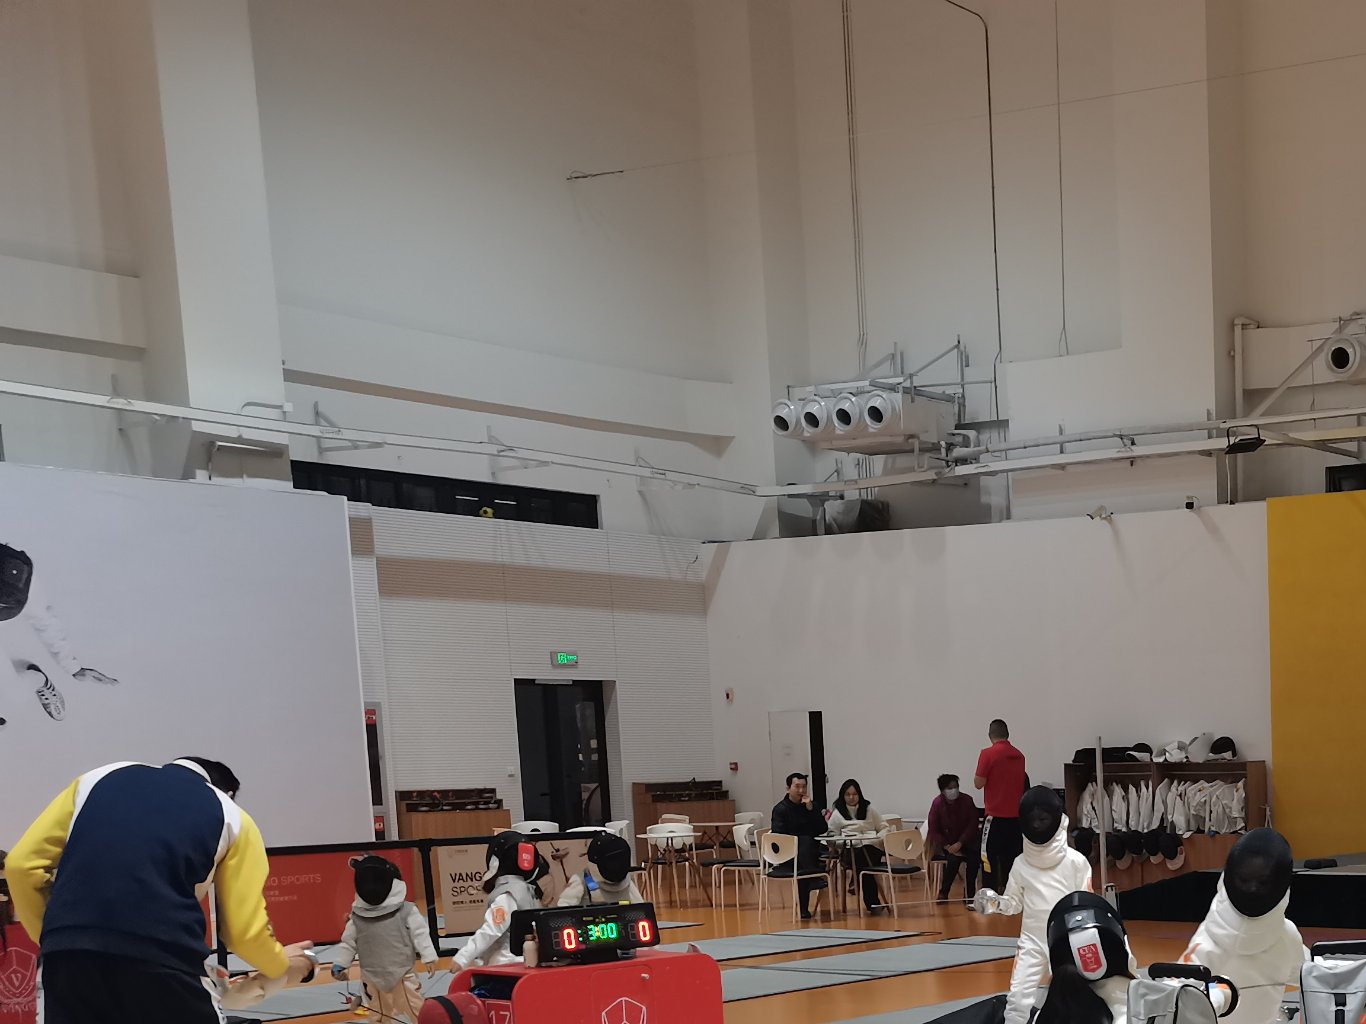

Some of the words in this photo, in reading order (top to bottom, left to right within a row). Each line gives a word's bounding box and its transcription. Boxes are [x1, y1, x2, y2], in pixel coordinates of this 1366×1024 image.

[281, 874, 322, 886] SPORTS
[562, 928, 576, 950] 0
[586, 922, 617, 941] 3:00
[638, 920, 651, 942] 0
